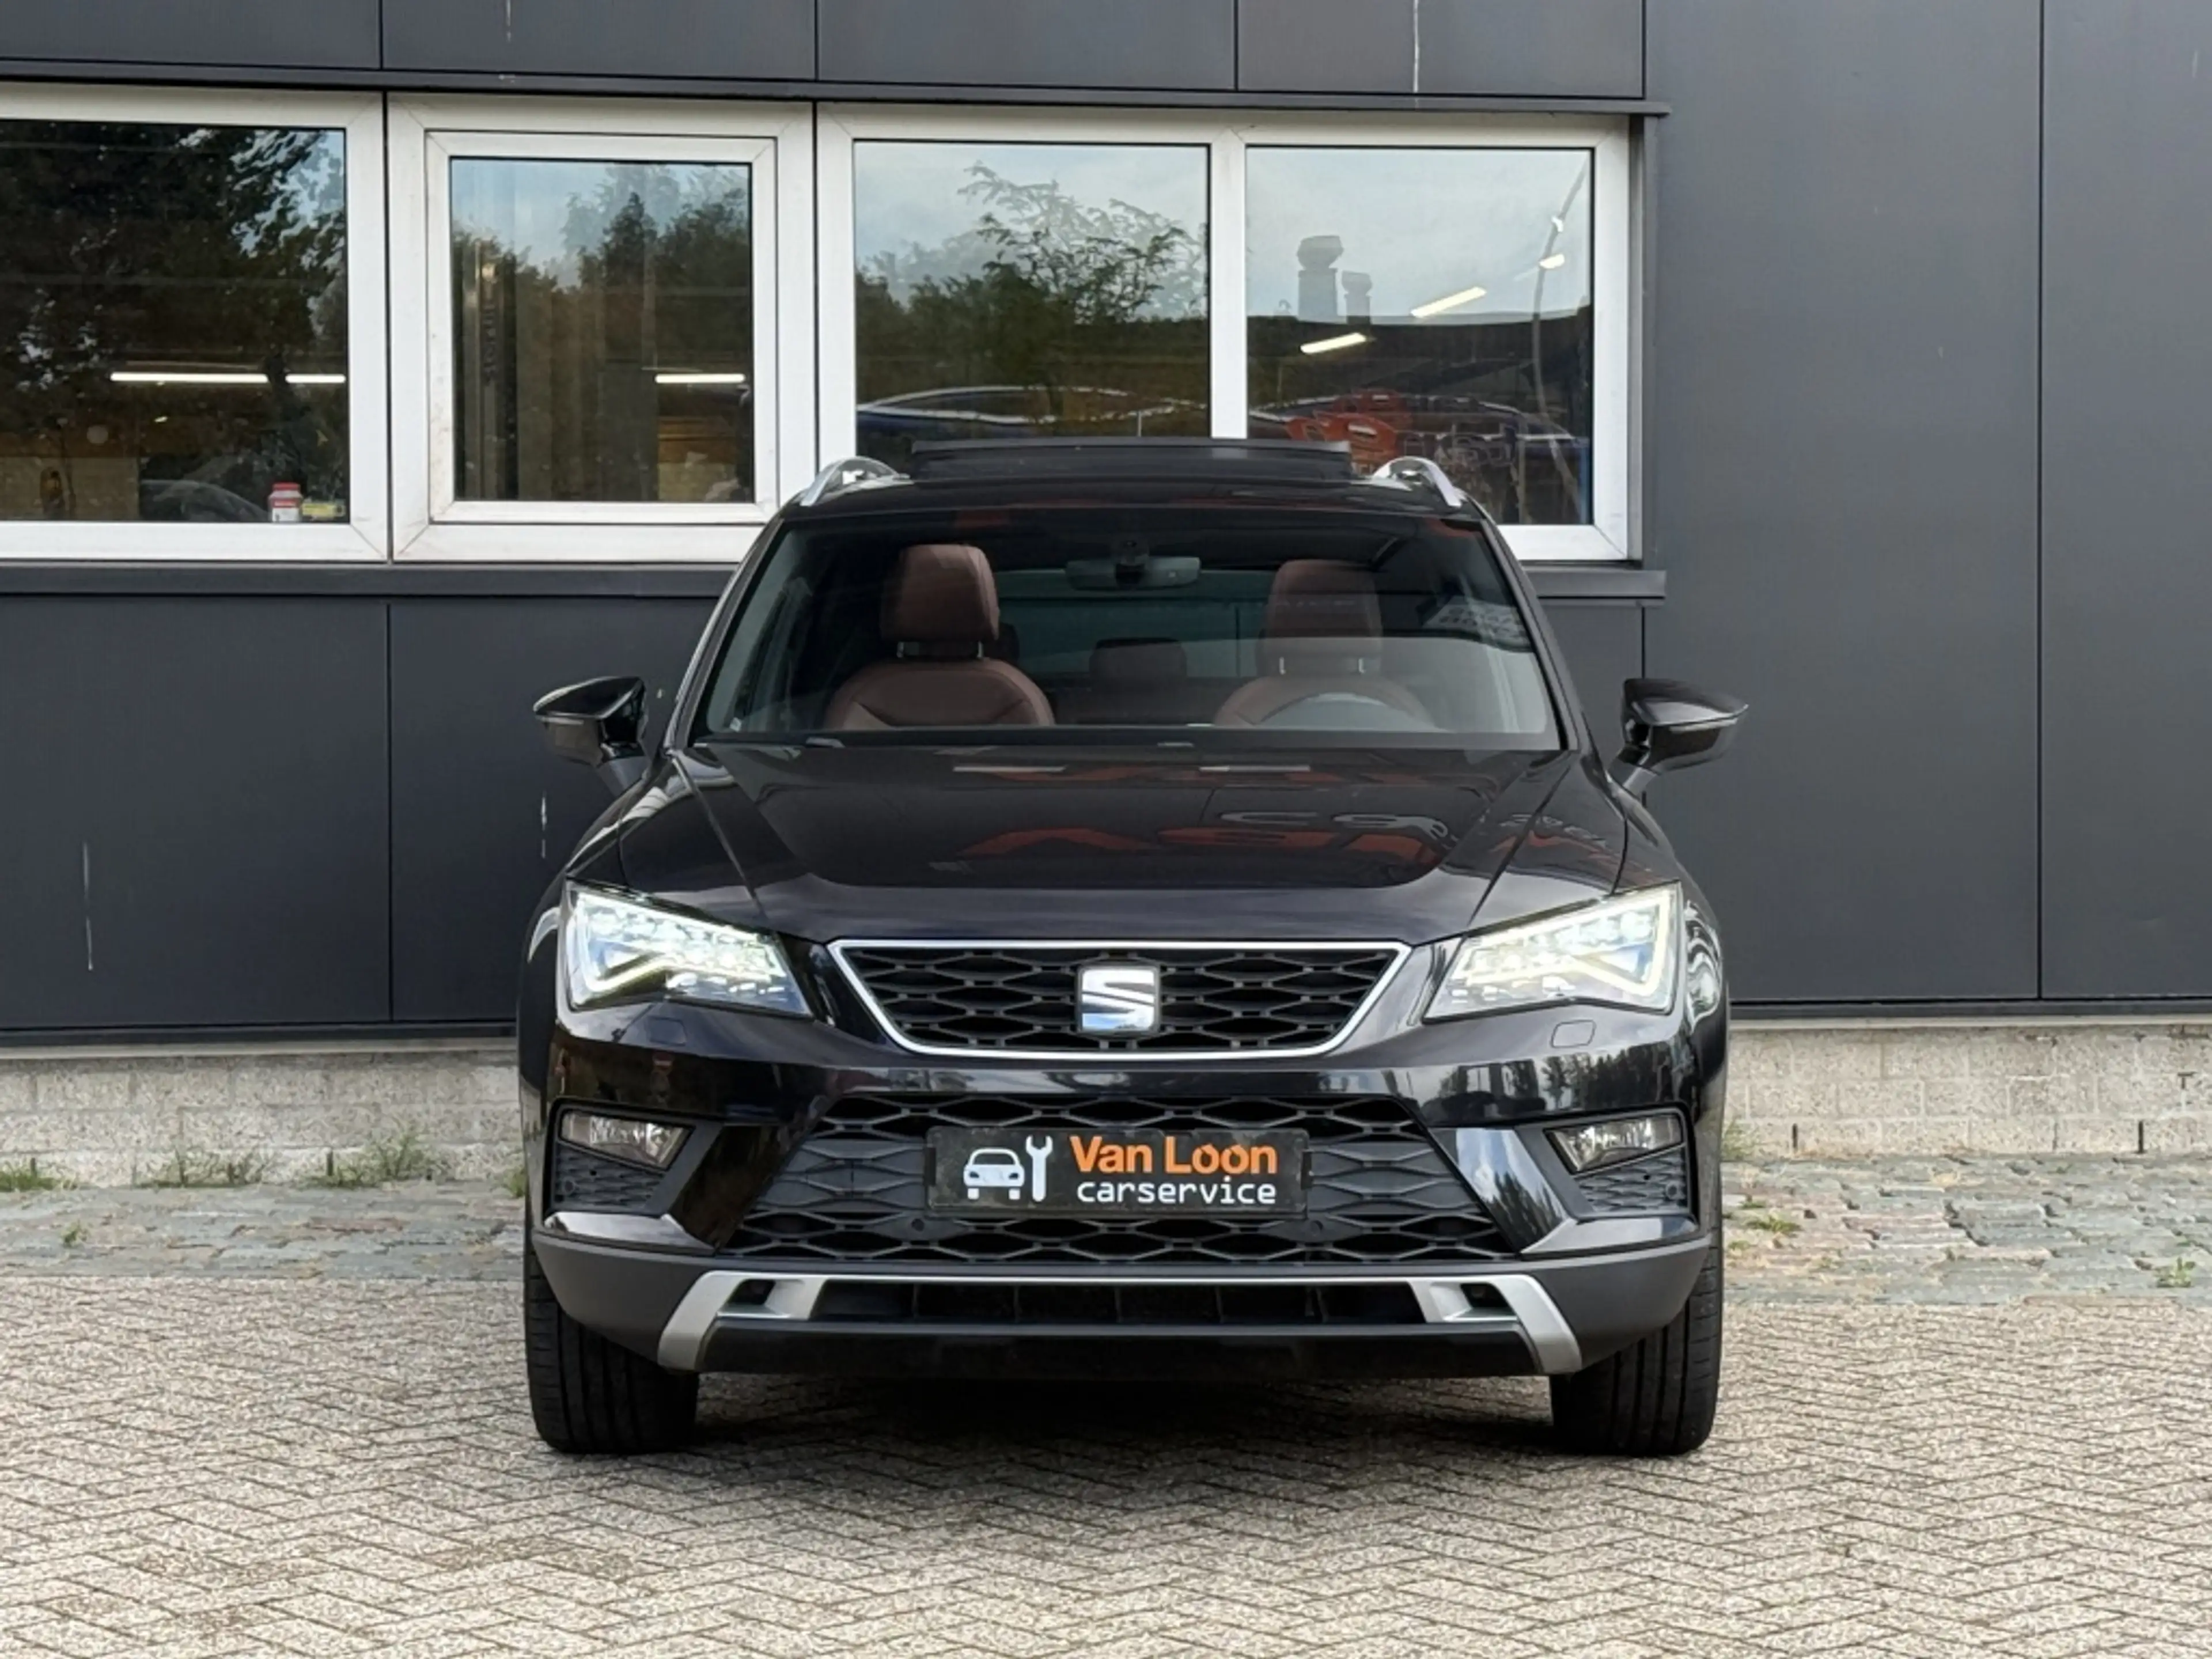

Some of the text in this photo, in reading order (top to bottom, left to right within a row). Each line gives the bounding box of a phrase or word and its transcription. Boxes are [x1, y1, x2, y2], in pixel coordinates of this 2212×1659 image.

[1070, 1135, 1278, 1175] Van Loon
[1077, 1176, 1277, 1205] carservice
